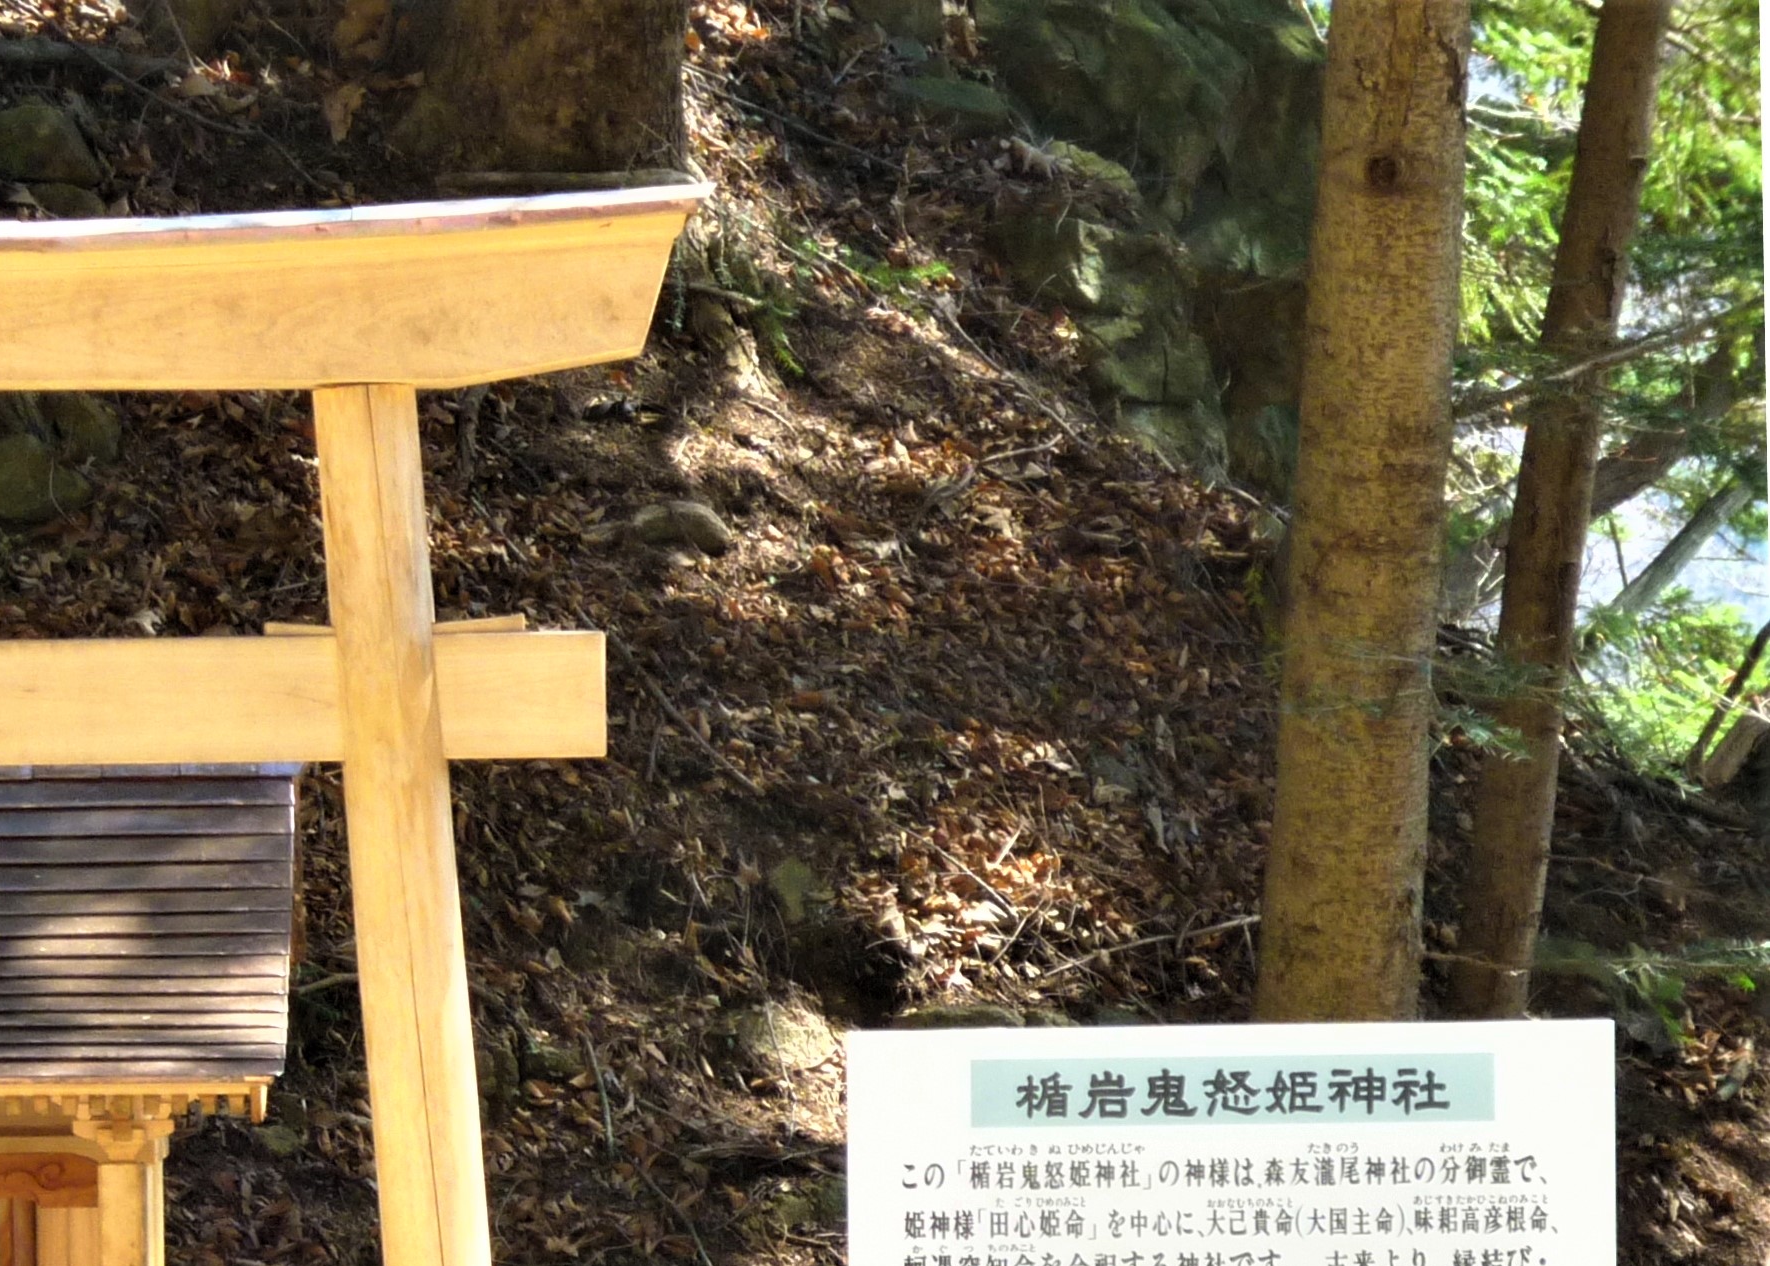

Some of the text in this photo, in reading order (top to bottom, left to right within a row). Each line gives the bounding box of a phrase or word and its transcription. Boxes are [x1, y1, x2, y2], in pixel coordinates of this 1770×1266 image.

[1016, 1067, 1449, 1118] 楯岩鬼怒姫神社
